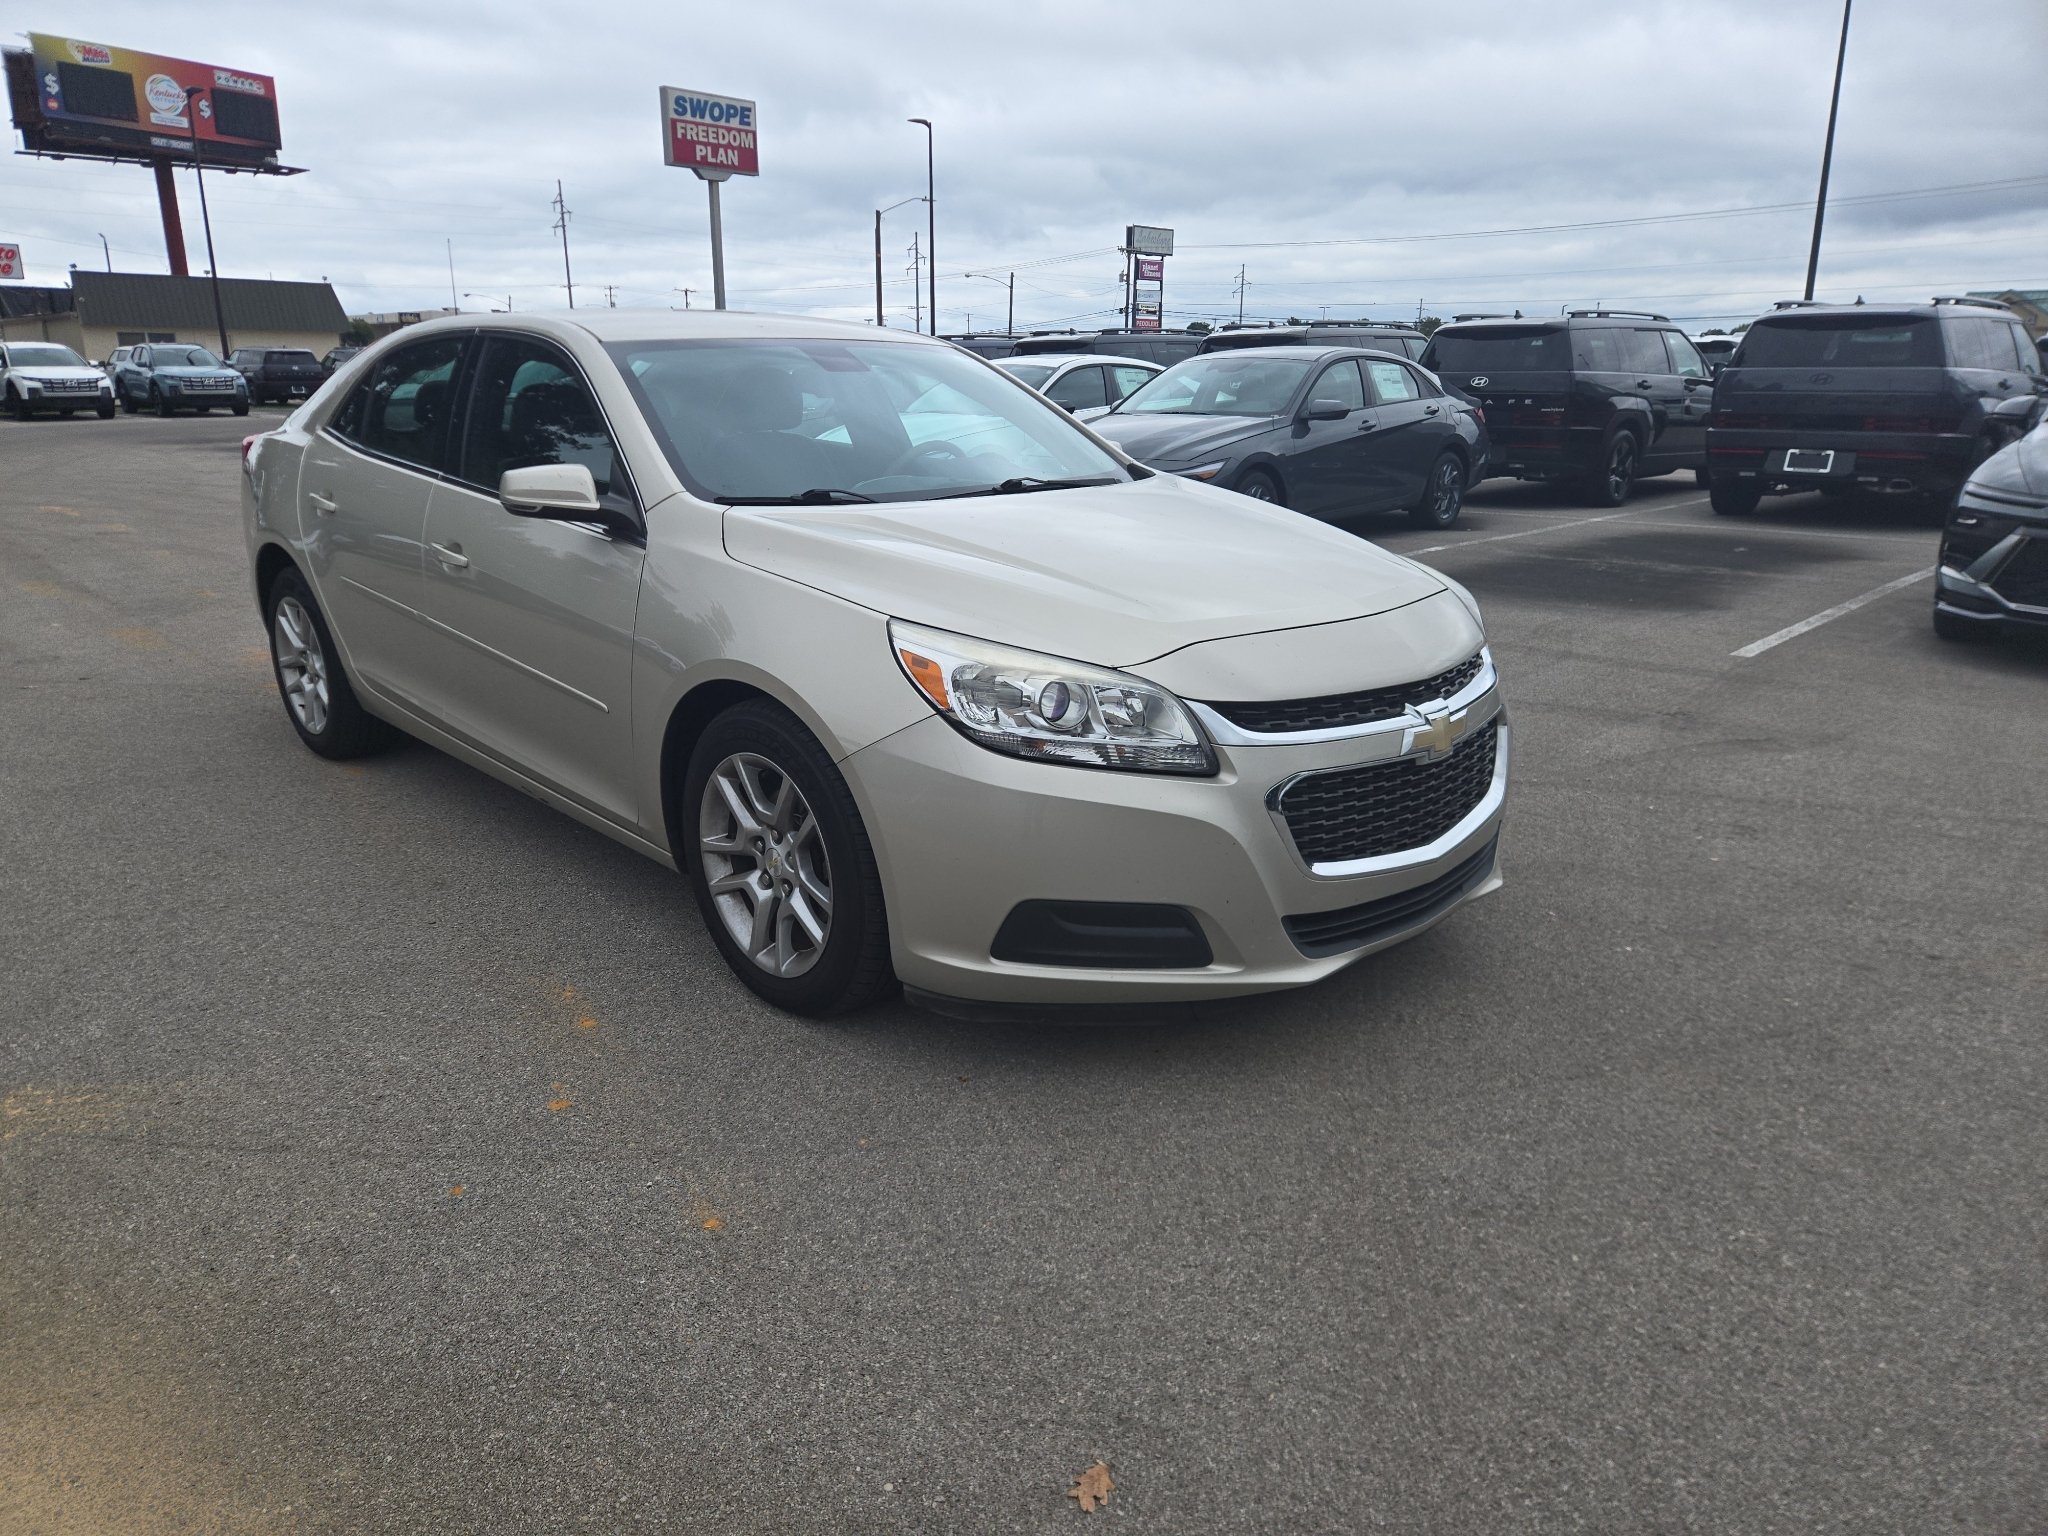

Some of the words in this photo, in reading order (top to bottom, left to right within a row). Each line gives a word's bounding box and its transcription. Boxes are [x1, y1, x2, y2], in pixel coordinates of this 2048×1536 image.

[673, 95, 752, 127] SWOPE
[676, 122, 754, 149] FREEDOM
[695, 144, 739, 167] PLAN
